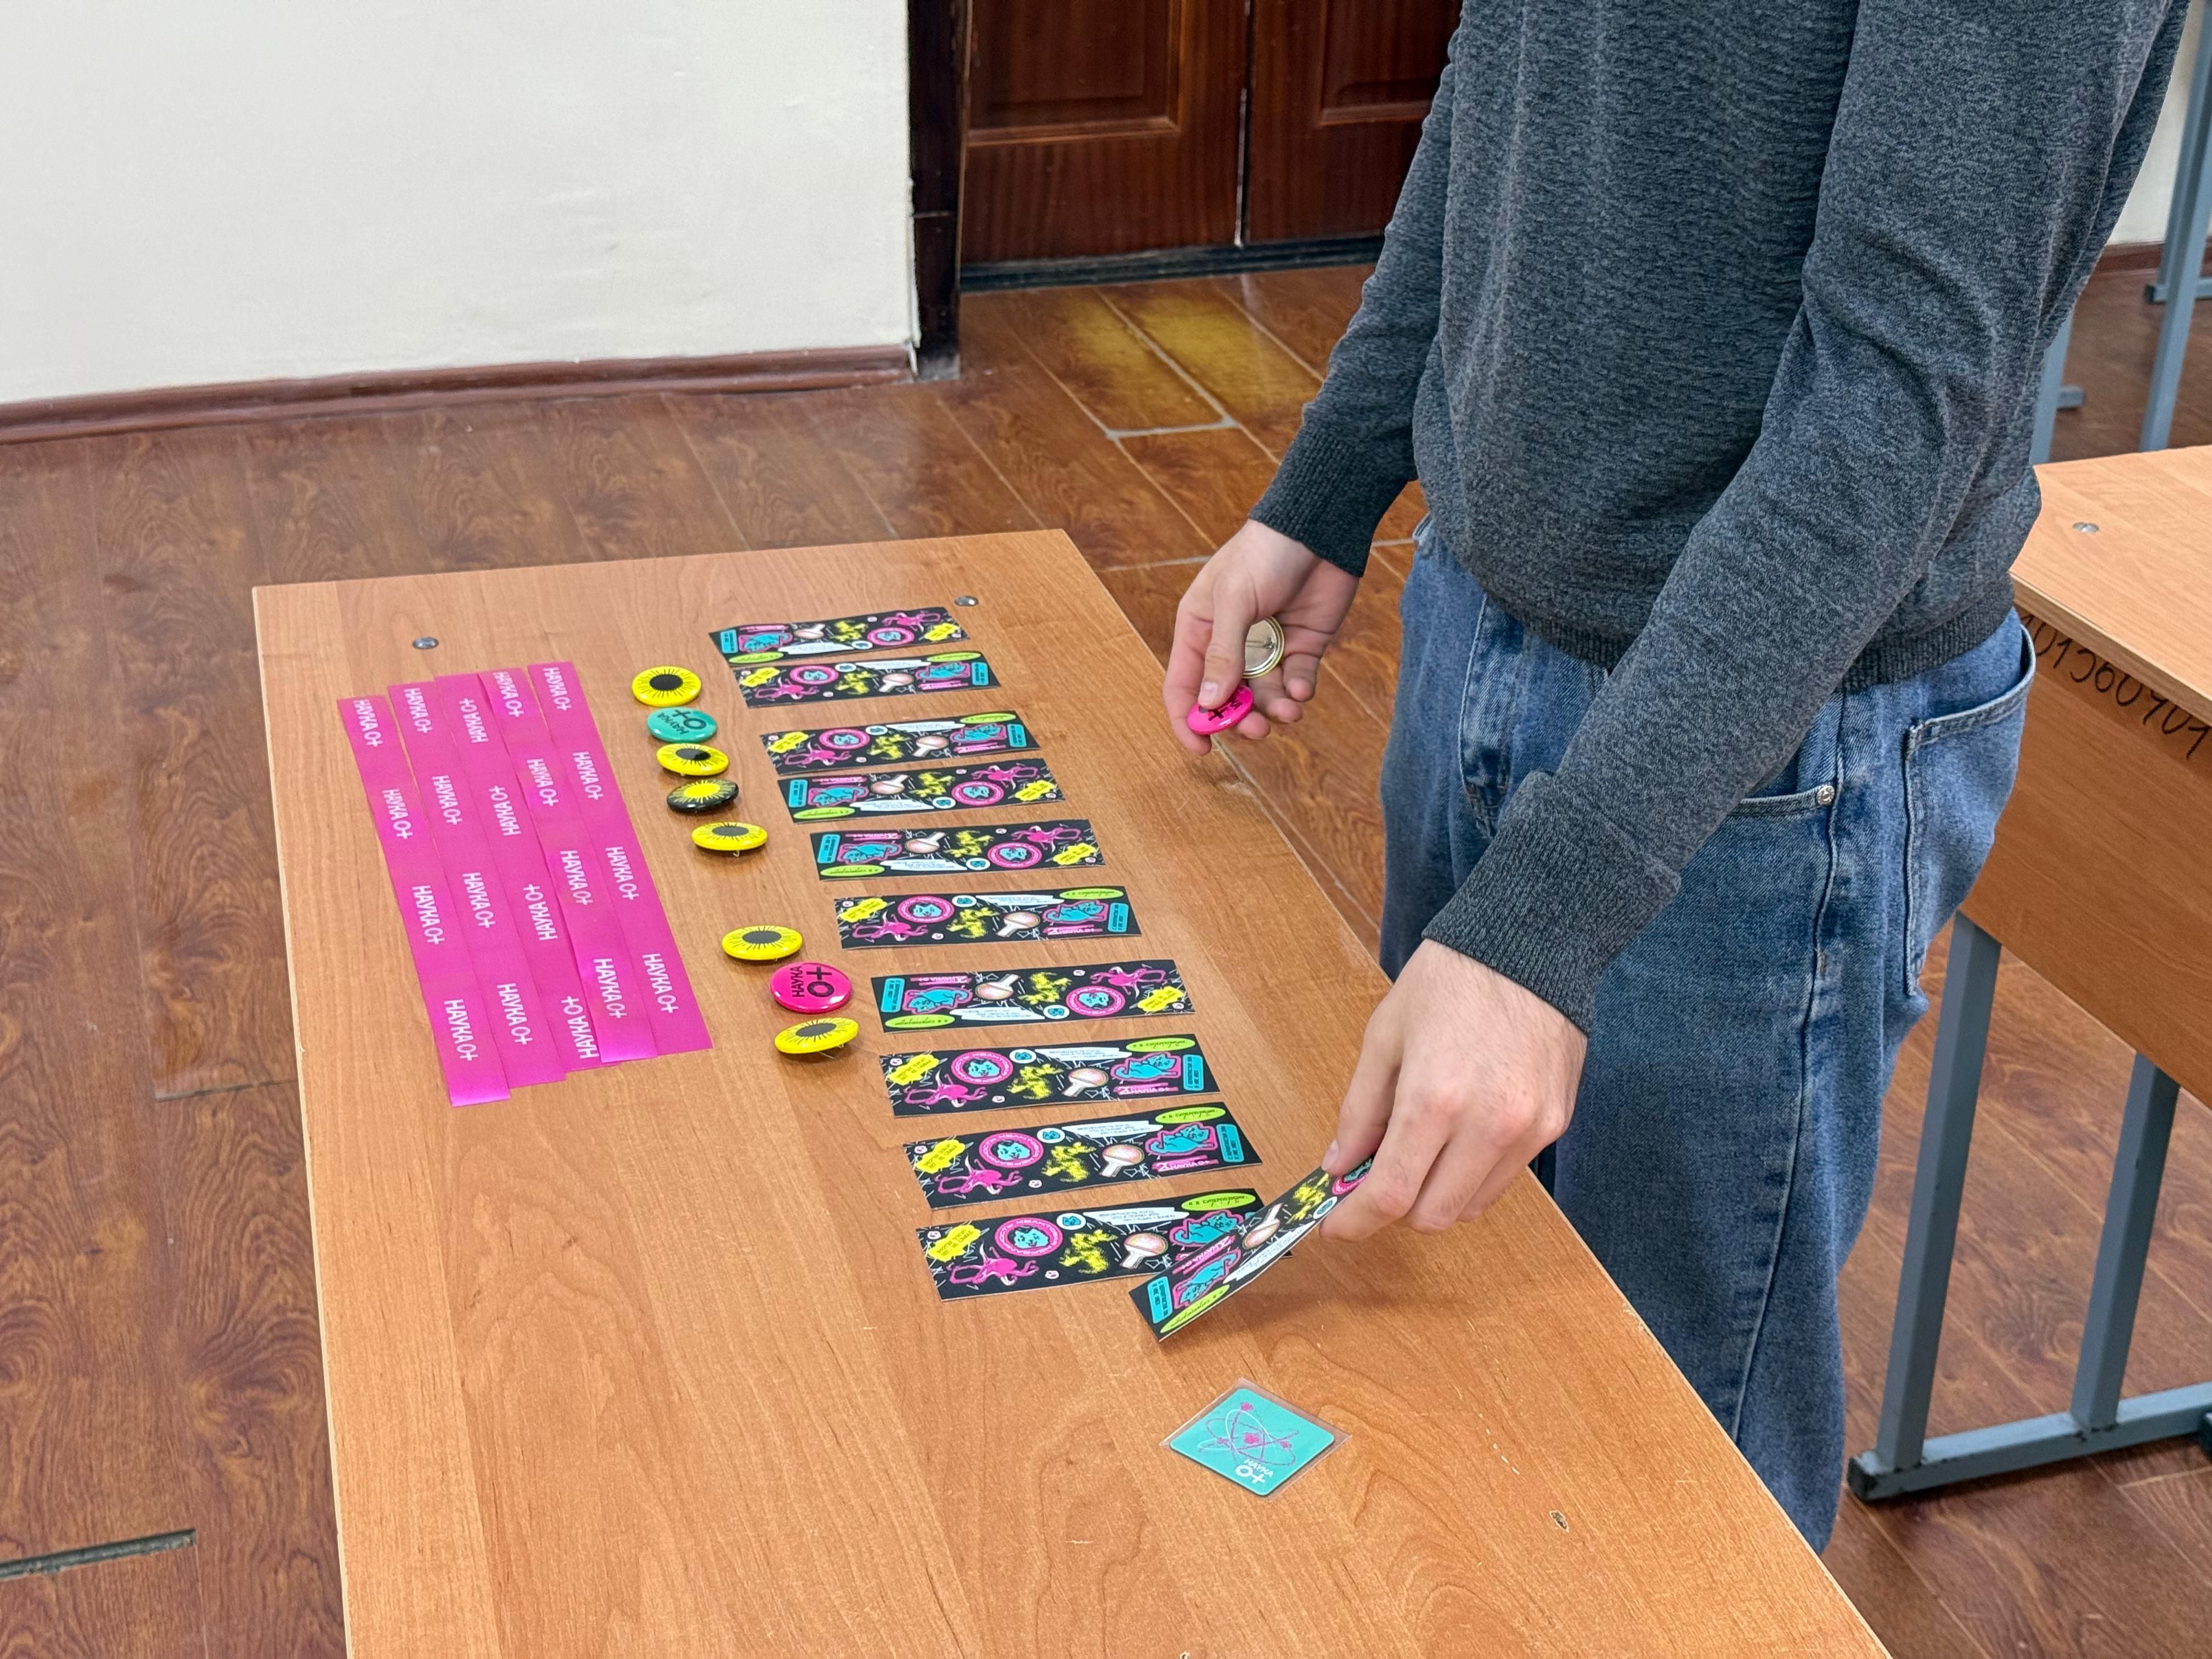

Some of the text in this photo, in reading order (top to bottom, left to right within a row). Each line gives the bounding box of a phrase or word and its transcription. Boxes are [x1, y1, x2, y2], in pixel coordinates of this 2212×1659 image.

[492, 670, 520, 700] НАУКА
[543, 666, 568, 698] НАУКА
[352, 697, 378, 731] НАУКА
[404, 688, 428, 720] НАУКА
[463, 712, 488, 743] НАУКА
[657, 713, 690, 735] НАУКА
[526, 758, 554, 789] НАУКА
[572, 751, 601, 786] НАУКА
[382, 789, 409, 821] НАУКА
[432, 775, 458, 809] НАУКА
[493, 800, 521, 836] НАУКА
[560, 850, 588, 891] НАУКА
[605, 845, 635, 884] НАУКА
[412, 885, 441, 928] НАУКА
[462, 872, 490, 911] НАУКА
[528, 901, 558, 940] НАУКА
[594, 958, 623, 1003] НАУКА
[641, 952, 674, 996] НАУКА
[789, 966, 805, 997] НАУКА
[444, 999, 474, 1044] НАУКА
[496, 983, 527, 1026] НАУКА
[567, 1015, 600, 1059] НАУКА
[1244, 1458, 1274, 1477] НАУКА
